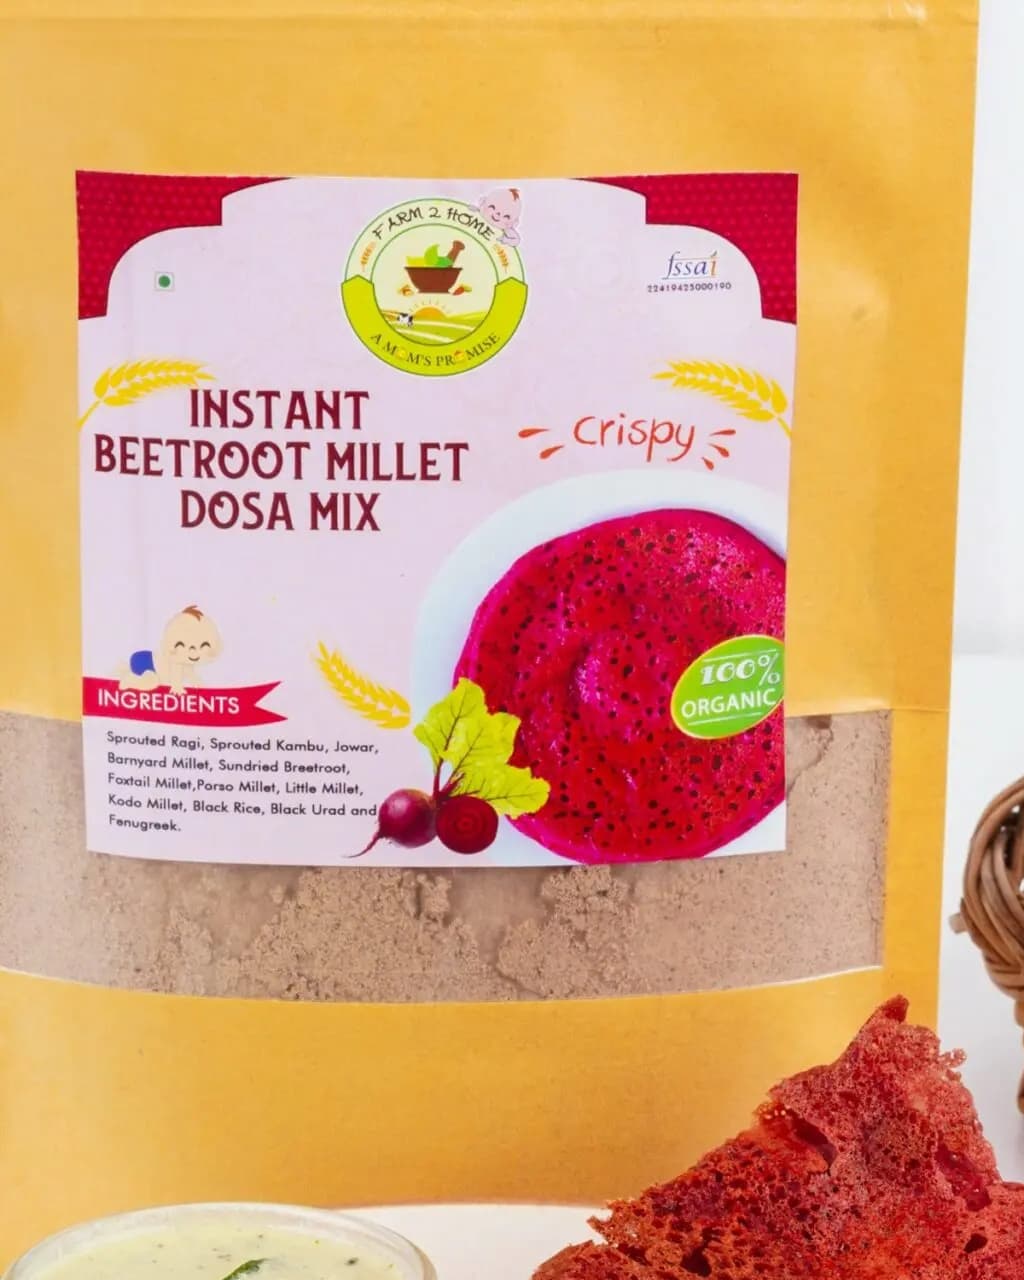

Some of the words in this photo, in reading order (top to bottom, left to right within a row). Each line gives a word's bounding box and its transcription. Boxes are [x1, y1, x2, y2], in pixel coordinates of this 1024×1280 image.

[372, 207, 423, 240] FARM
[429, 207, 442, 219] 2
[447, 207, 495, 241] HOME
[662, 250, 718, 280] fssai
[371, 333, 383, 344] A
[189, 388, 370, 430] INSTANT
[573, 412, 695, 463] crispy
[94, 433, 311, 480] BEETROOT
[326, 441, 470, 481] MILLET
[180, 489, 294, 531] DOSA
[309, 492, 381, 531] MIX
[701, 652, 780, 686] 100%
[97, 688, 241, 715] INGREDIENTS
[681, 687, 777, 719] ORGANIC
[106, 730, 166, 747] Sprouted
[171, 735, 205, 751] Ragi,
[210, 737, 271, 752] Sprouted
[276, 739, 329, 754] Kambu,
[334, 740, 379, 755] Jowar,
[107, 752, 167, 768] Barnyard
[171, 757, 213, 772] Millet,
[218, 759, 279, 773] Sundried
[284, 761, 351, 775] Breetroot,
[107, 772, 150, 787] Foxtail
[239, 781, 280, 795] Millet,
[285, 782, 317, 794] Little
[321, 783, 364, 797] Millet,
[108, 794, 142, 808] Kodo
[146, 797, 187, 813] Millet,
[192, 800, 229, 813] Black
[233, 801, 265, 816] Rice,
[270, 802, 307, 815] Black
[311, 804, 346, 816] Urad
[350, 804, 377, 817] and
[108, 814, 182, 832] Fenugreek.
